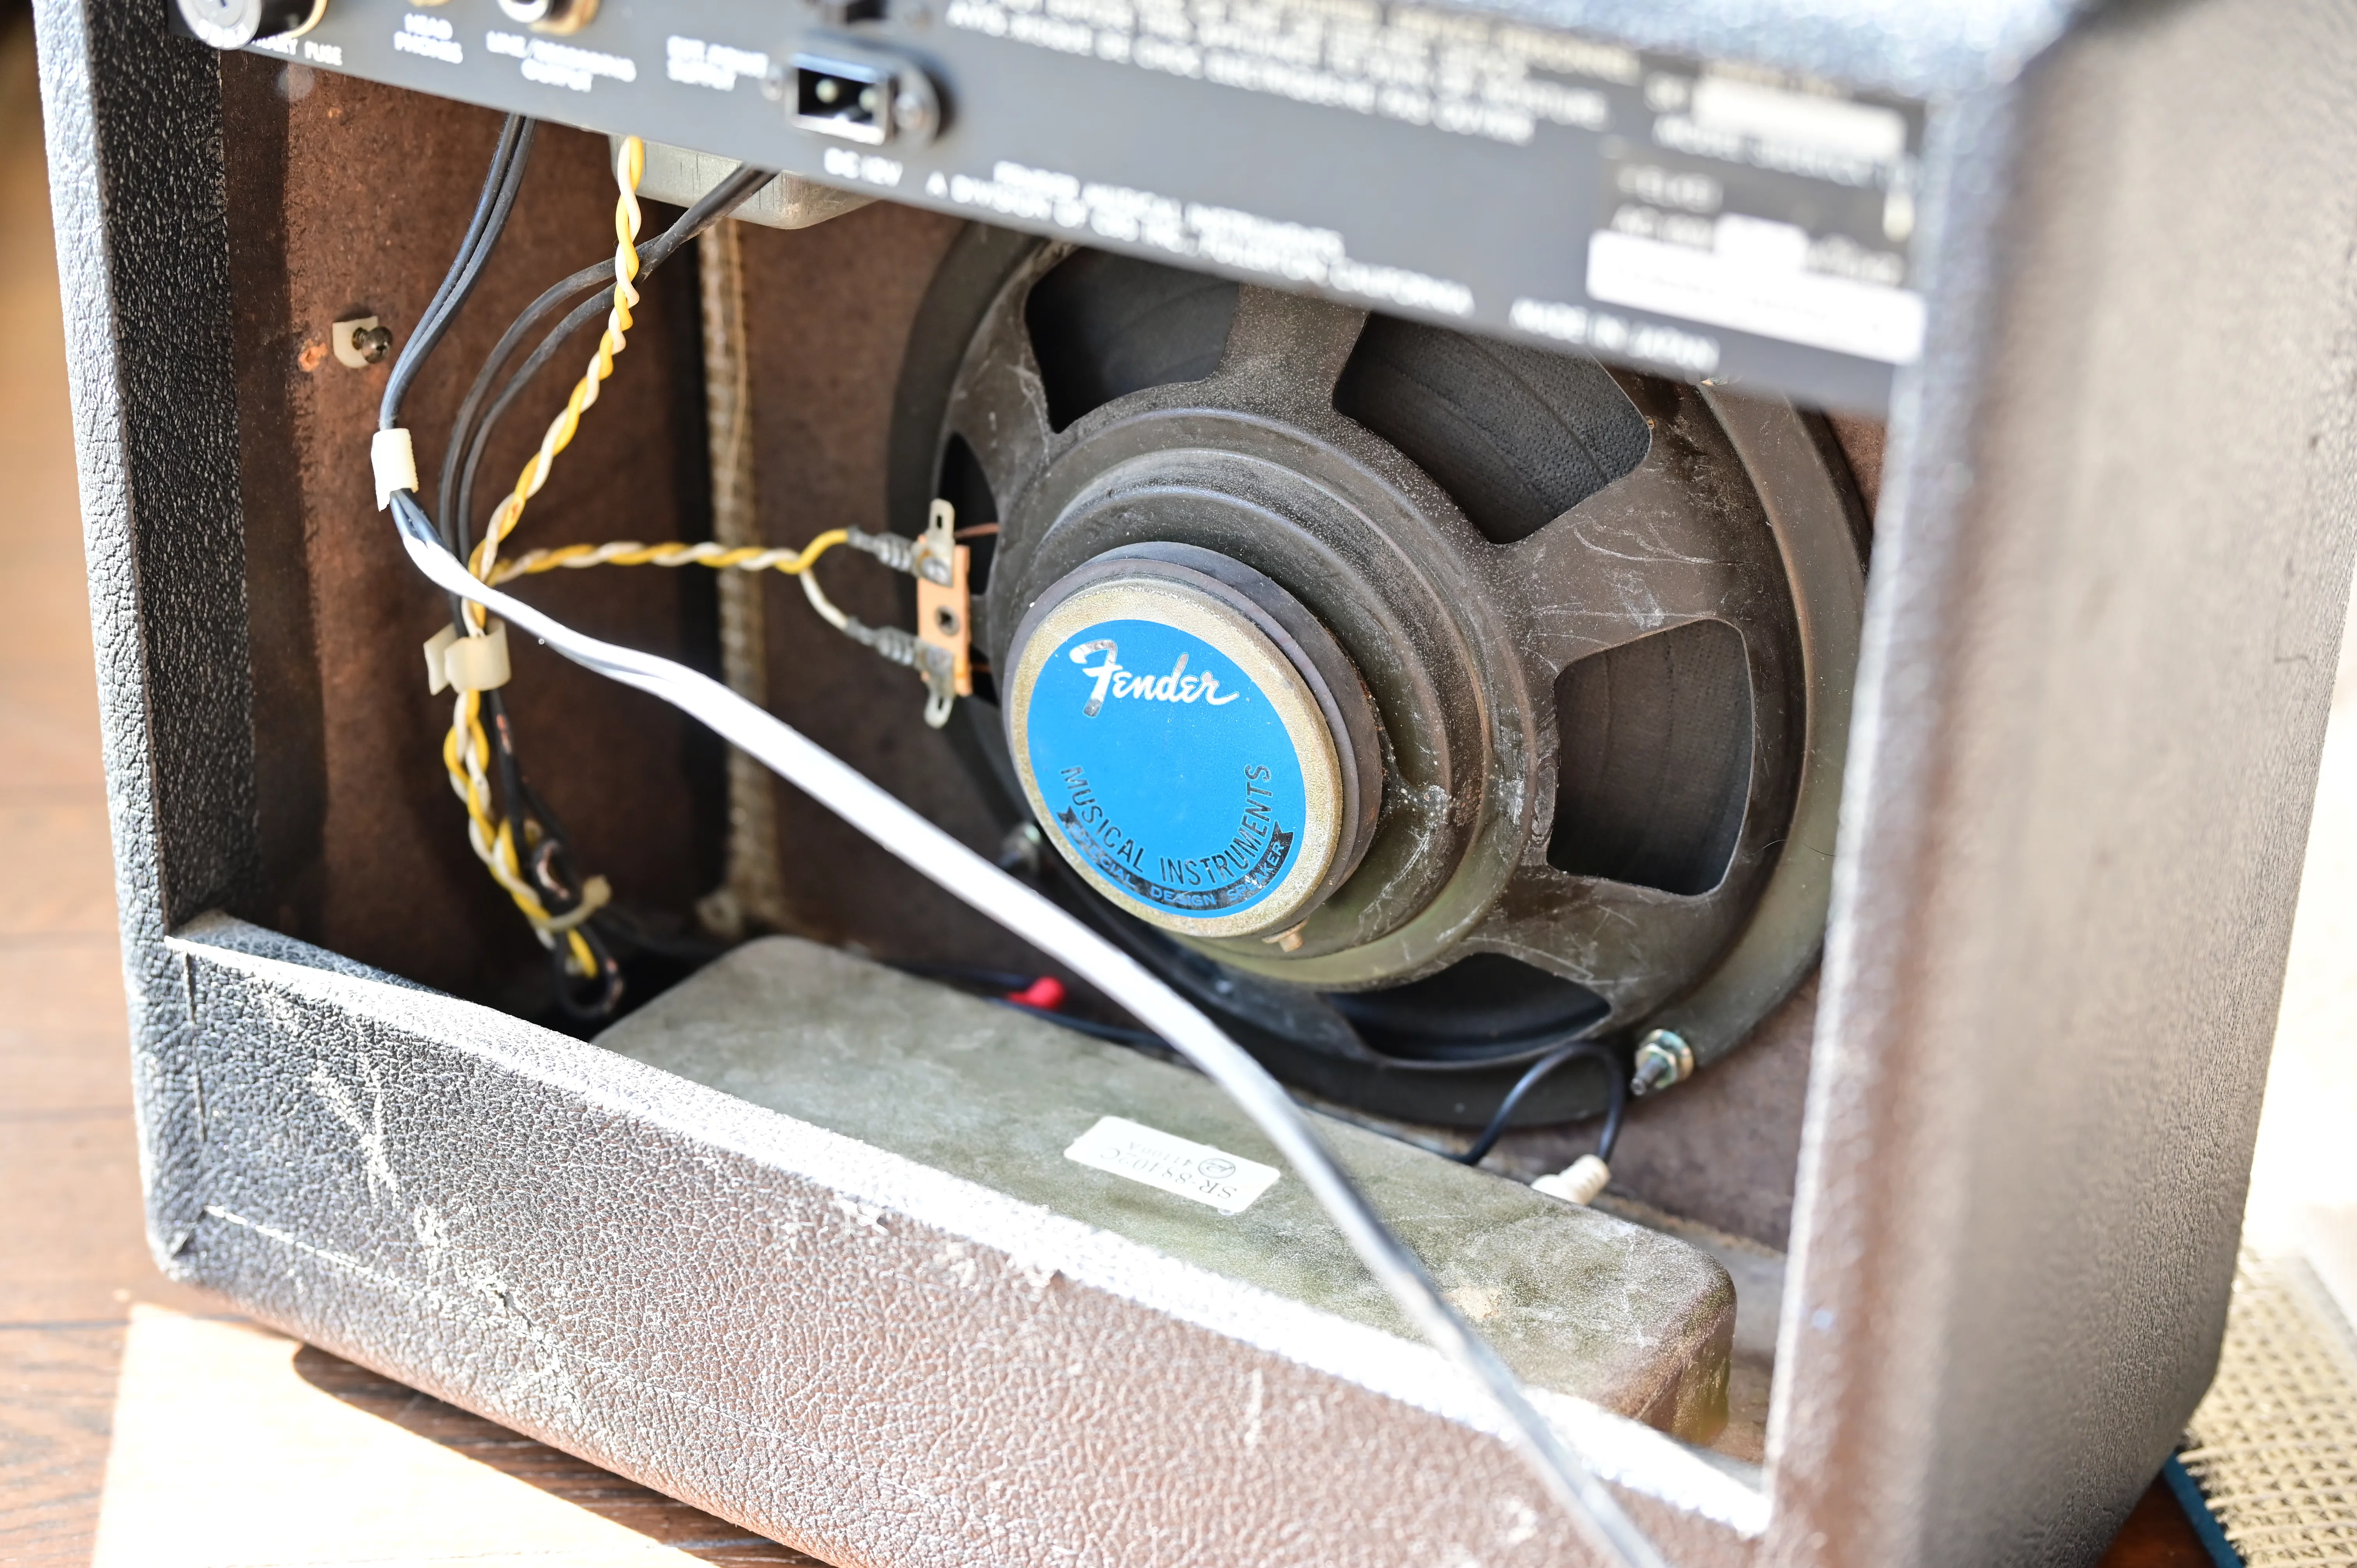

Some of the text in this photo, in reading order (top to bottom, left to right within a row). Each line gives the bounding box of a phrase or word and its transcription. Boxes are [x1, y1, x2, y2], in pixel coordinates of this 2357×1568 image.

[1069, 638, 1239, 717] Fender
[1060, 763, 1274, 886] MUSICAL INSTRUMENTS
[1067, 821, 1285, 906] SPECIAL DESIGN SPEAKER
